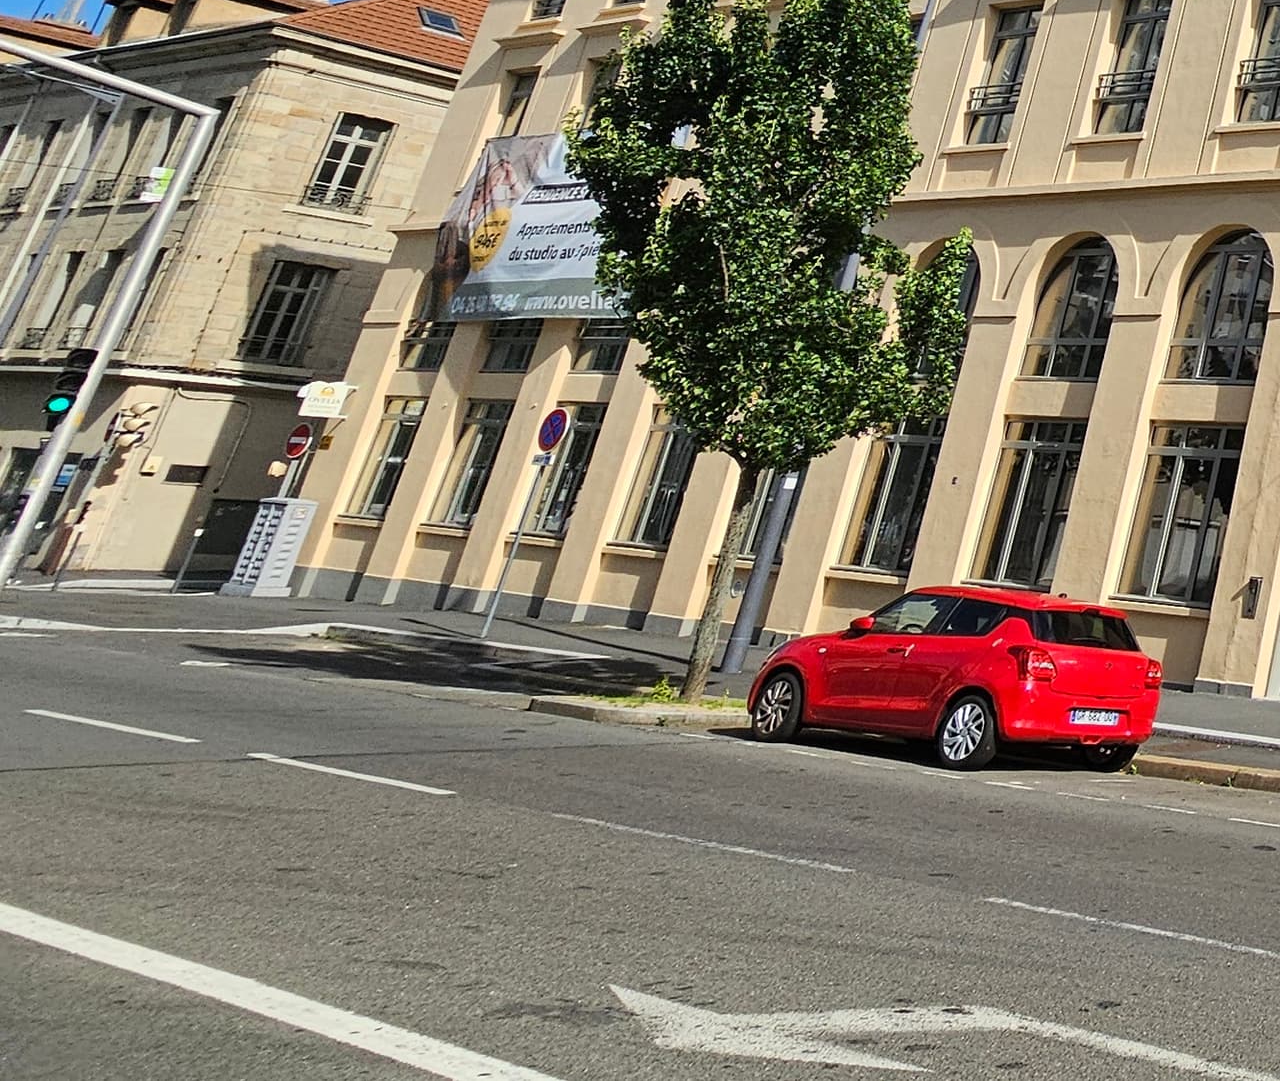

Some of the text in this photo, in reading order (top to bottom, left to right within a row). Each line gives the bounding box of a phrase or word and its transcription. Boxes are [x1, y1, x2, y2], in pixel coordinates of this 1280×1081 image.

[516, 221, 591, 241] Appartements
[508, 246, 523, 262] du
[523, 244, 558, 261] studio
[559, 247, 576, 260] au
